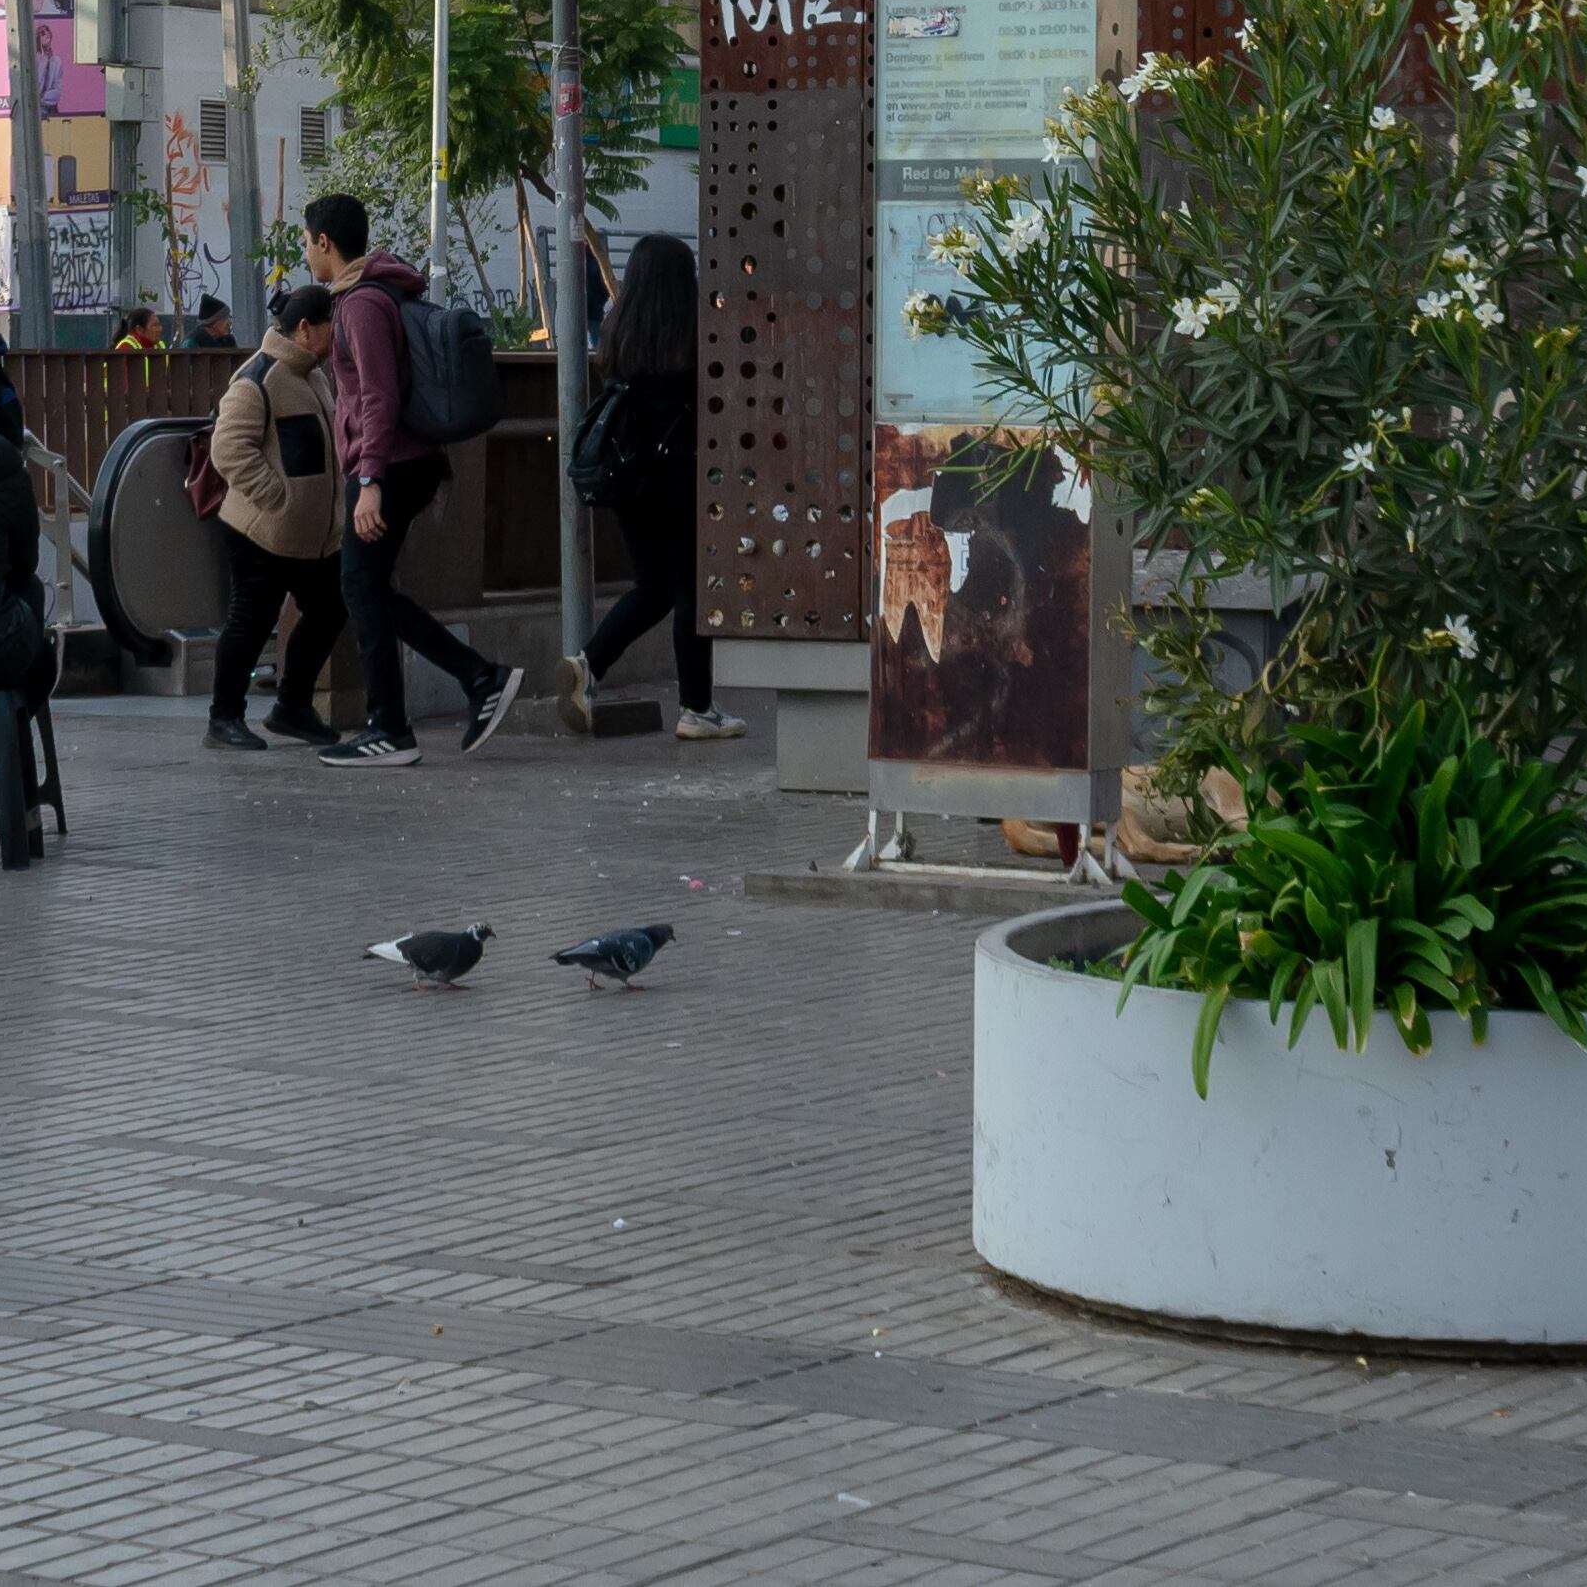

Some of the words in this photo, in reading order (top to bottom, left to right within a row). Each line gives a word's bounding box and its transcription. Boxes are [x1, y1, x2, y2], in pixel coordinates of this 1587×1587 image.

[902, 166, 929, 181] Red
[933, 166, 950, 180] de
[68, 192, 101, 205] MALETAS
